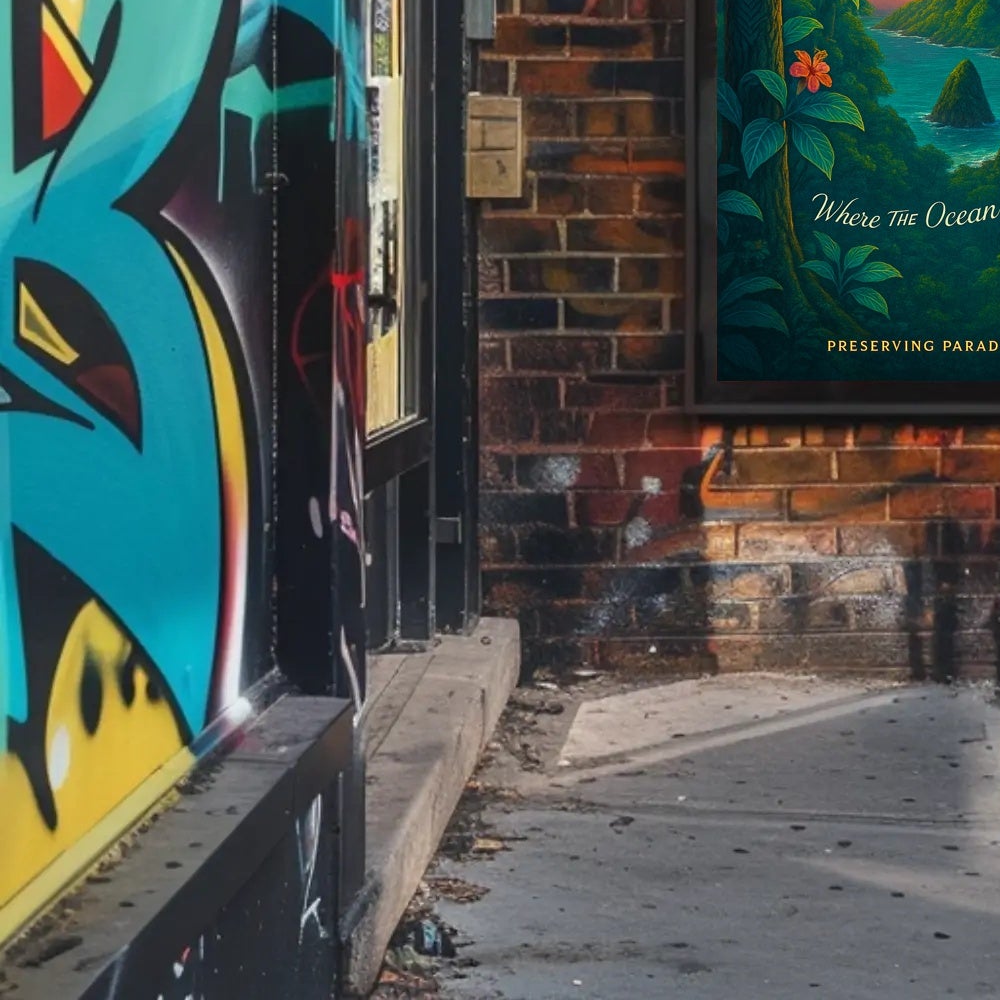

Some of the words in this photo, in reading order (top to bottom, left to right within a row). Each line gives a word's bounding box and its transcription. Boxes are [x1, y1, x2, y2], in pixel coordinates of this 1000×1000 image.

[811, 192, 881, 229] Where
[887, 209, 919, 227] THE
[925, 201, 1000, 229] Ocean
[827, 340, 935, 352] PRESERVING
